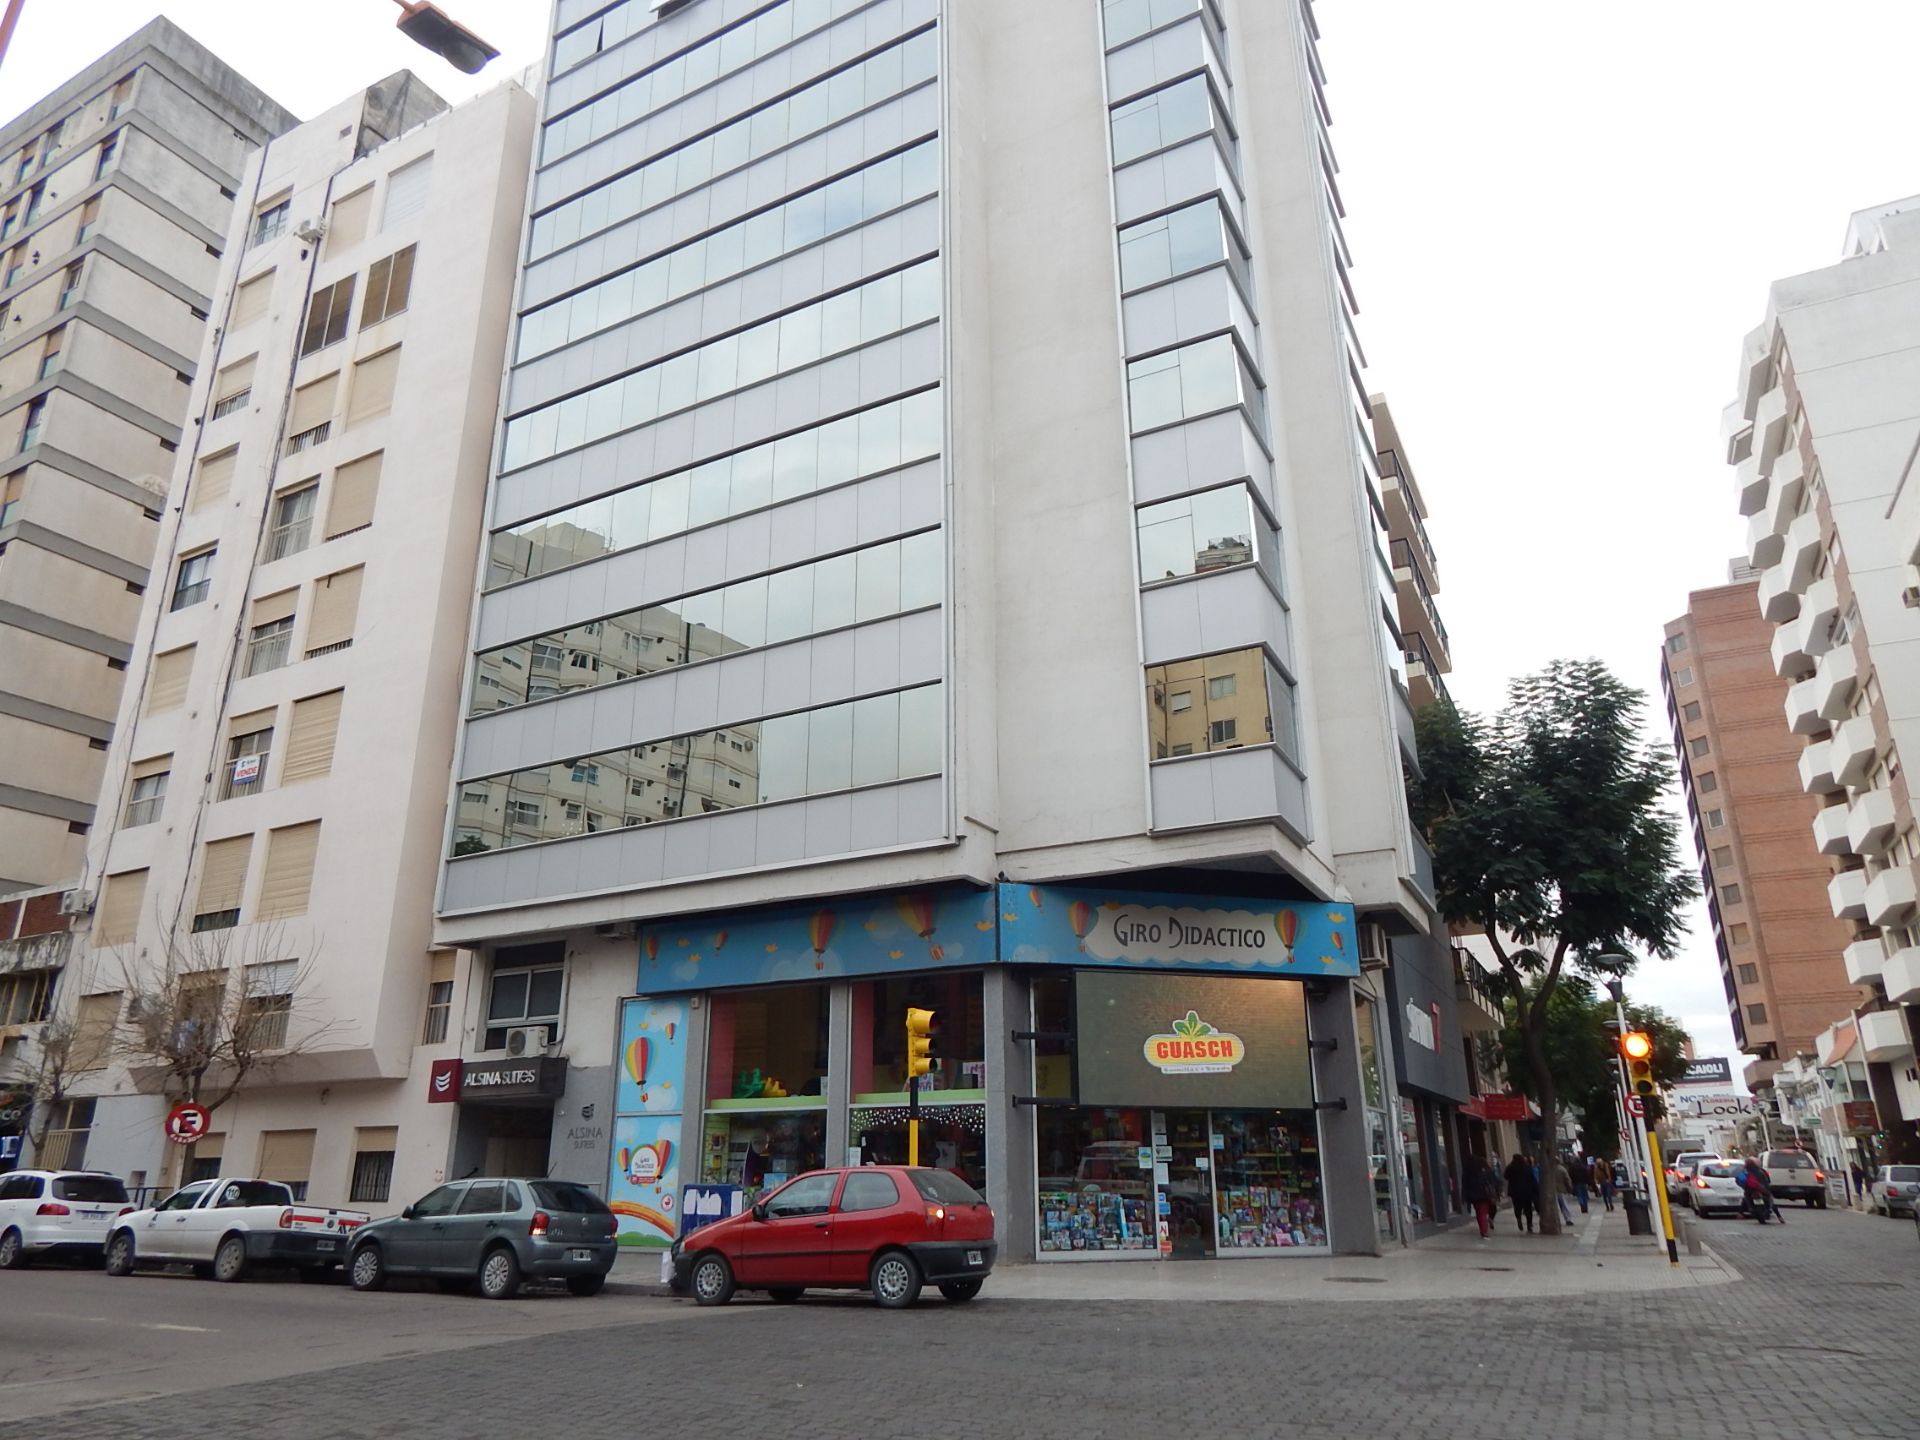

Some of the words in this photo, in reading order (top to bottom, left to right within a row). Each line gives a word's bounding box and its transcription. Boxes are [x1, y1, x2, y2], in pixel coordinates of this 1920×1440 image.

[1113, 914, 1162, 947] GIRO
[1168, 916, 1266, 949] DIDACTICO
[1156, 1040, 1233, 1059] GUASCH
[464, 1072, 501, 1086] ALSINA
[1697, 1097, 1751, 1118] Look
[567, 1127, 604, 1139] ALSINA
